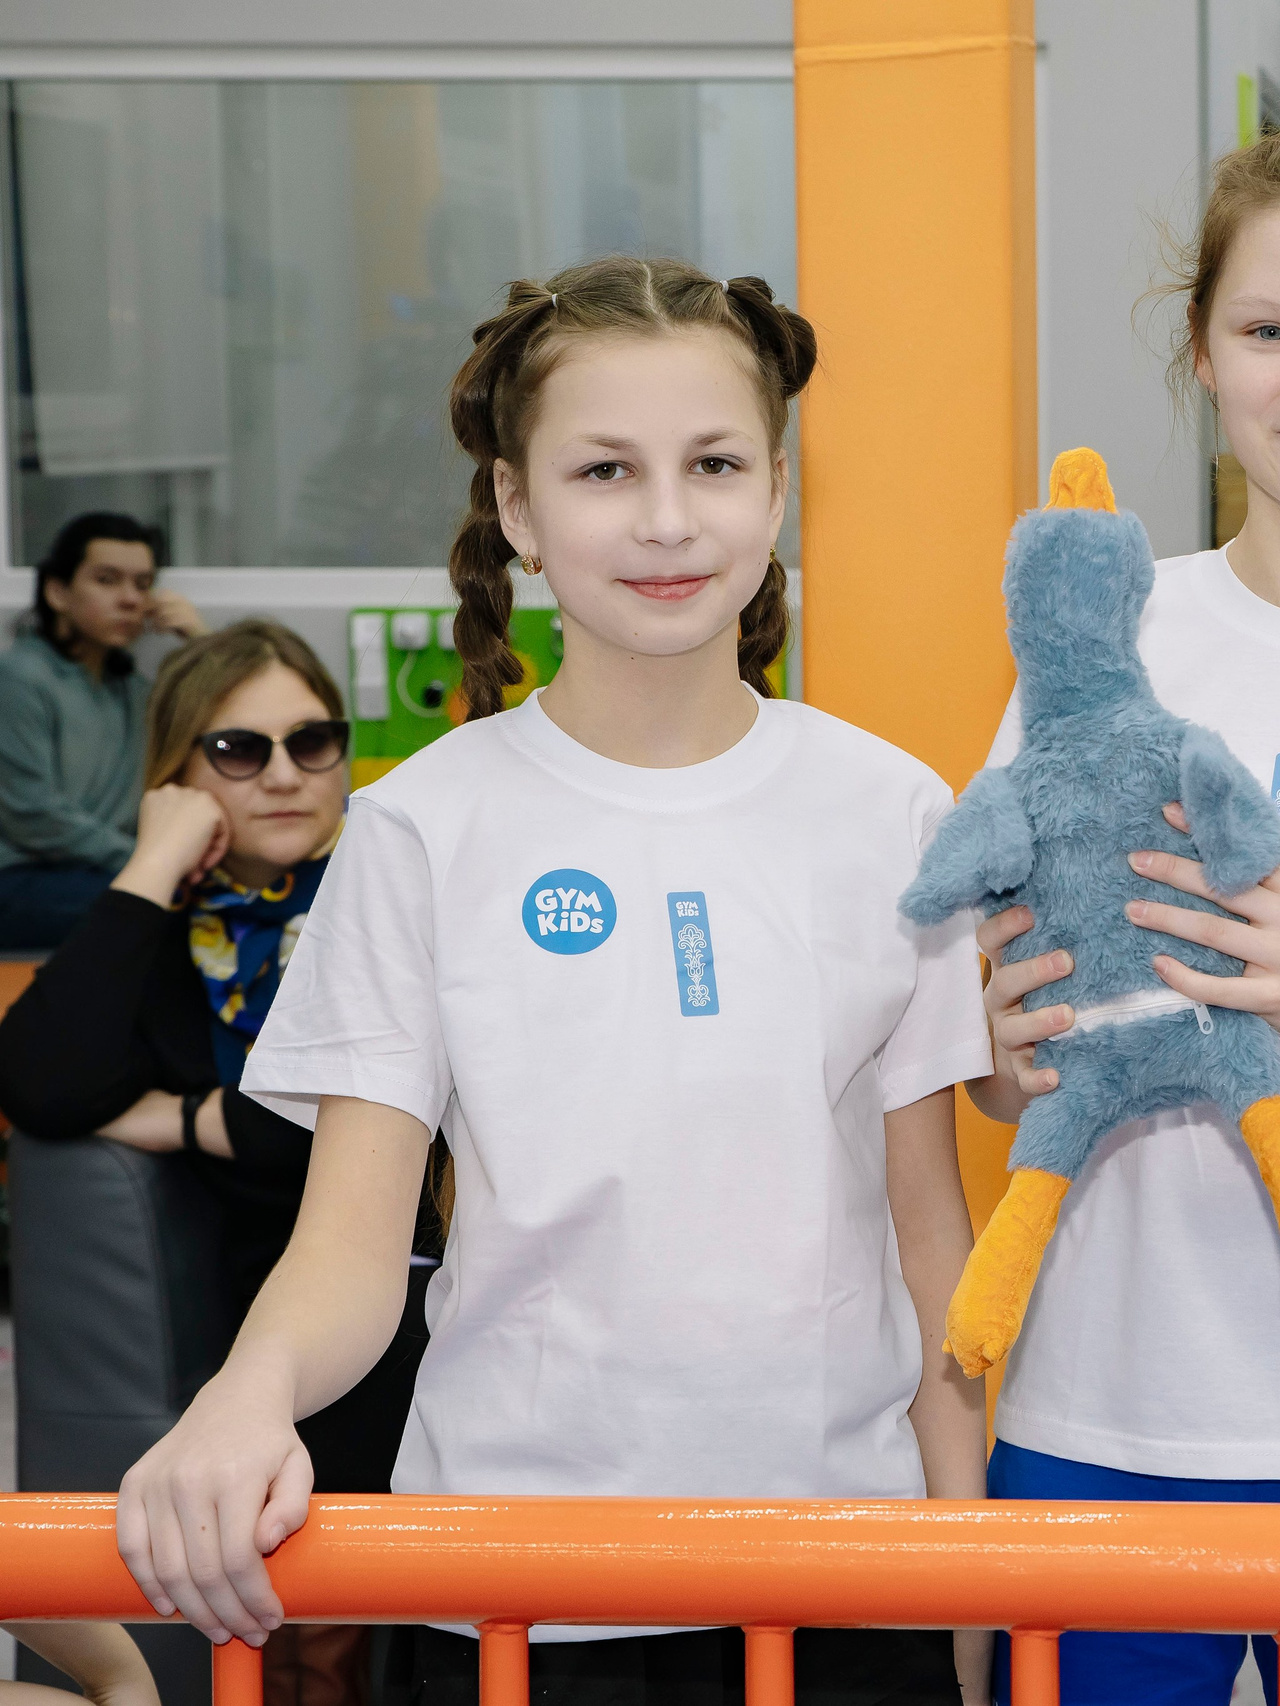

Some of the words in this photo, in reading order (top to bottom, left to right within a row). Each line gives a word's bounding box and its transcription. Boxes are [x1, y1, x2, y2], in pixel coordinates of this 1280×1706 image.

[535, 887, 602, 913] GYM
[675, 901, 698, 911] GYM
[537, 910, 604, 936] KiDs
